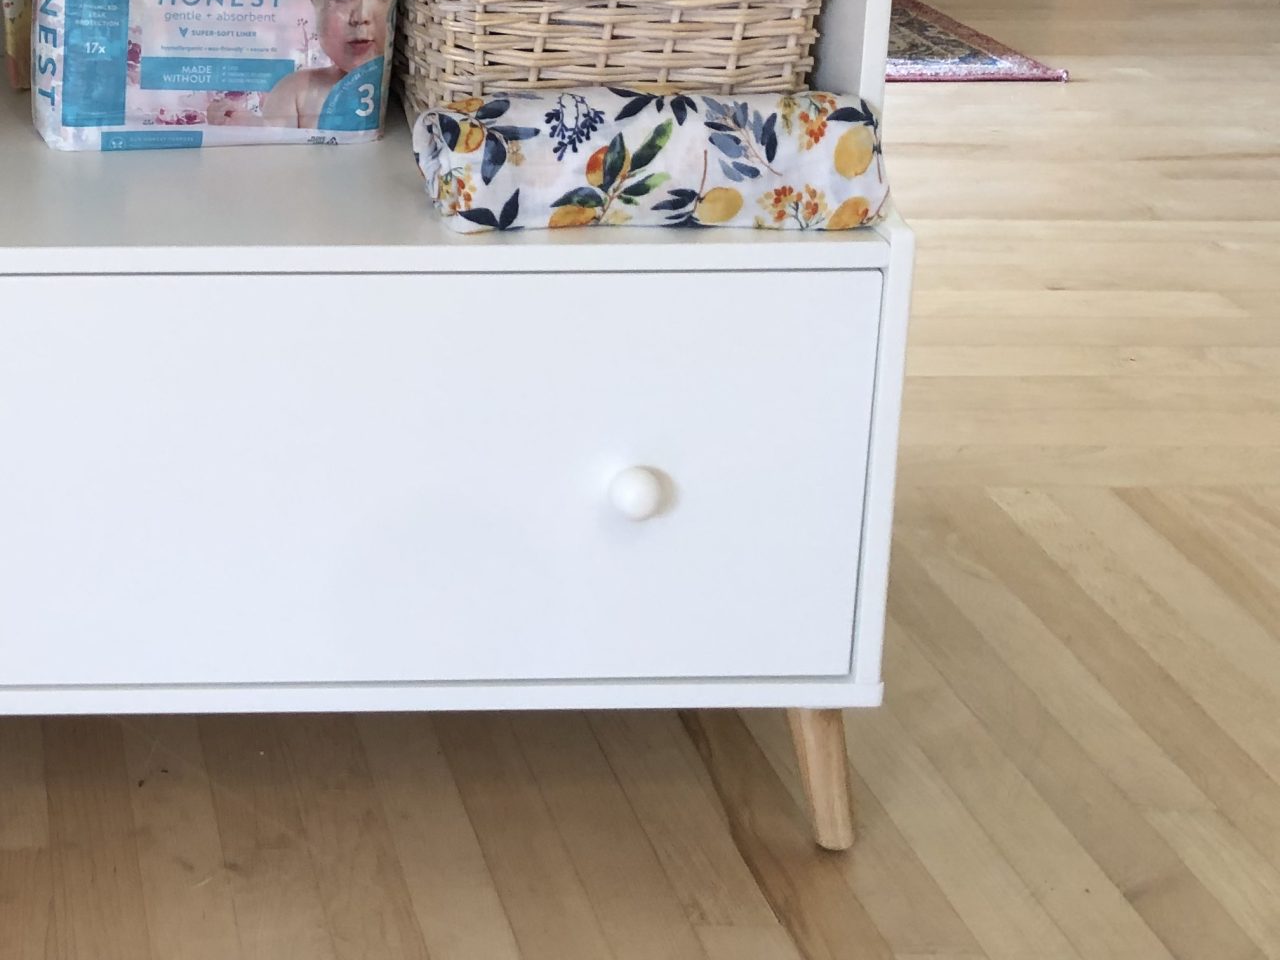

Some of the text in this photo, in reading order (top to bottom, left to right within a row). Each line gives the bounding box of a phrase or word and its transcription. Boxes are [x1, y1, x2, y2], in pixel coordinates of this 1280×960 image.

[164, 11, 202, 22] gentle
[216, 11, 277, 22] absorbent
[191, 29, 234, 37] SUPER-SOFT
[84, 42, 106, 54] 17x
[182, 65, 213, 74] MADE
[163, 74, 212, 84] WITHOUT
[355, 83, 375, 117] 3
